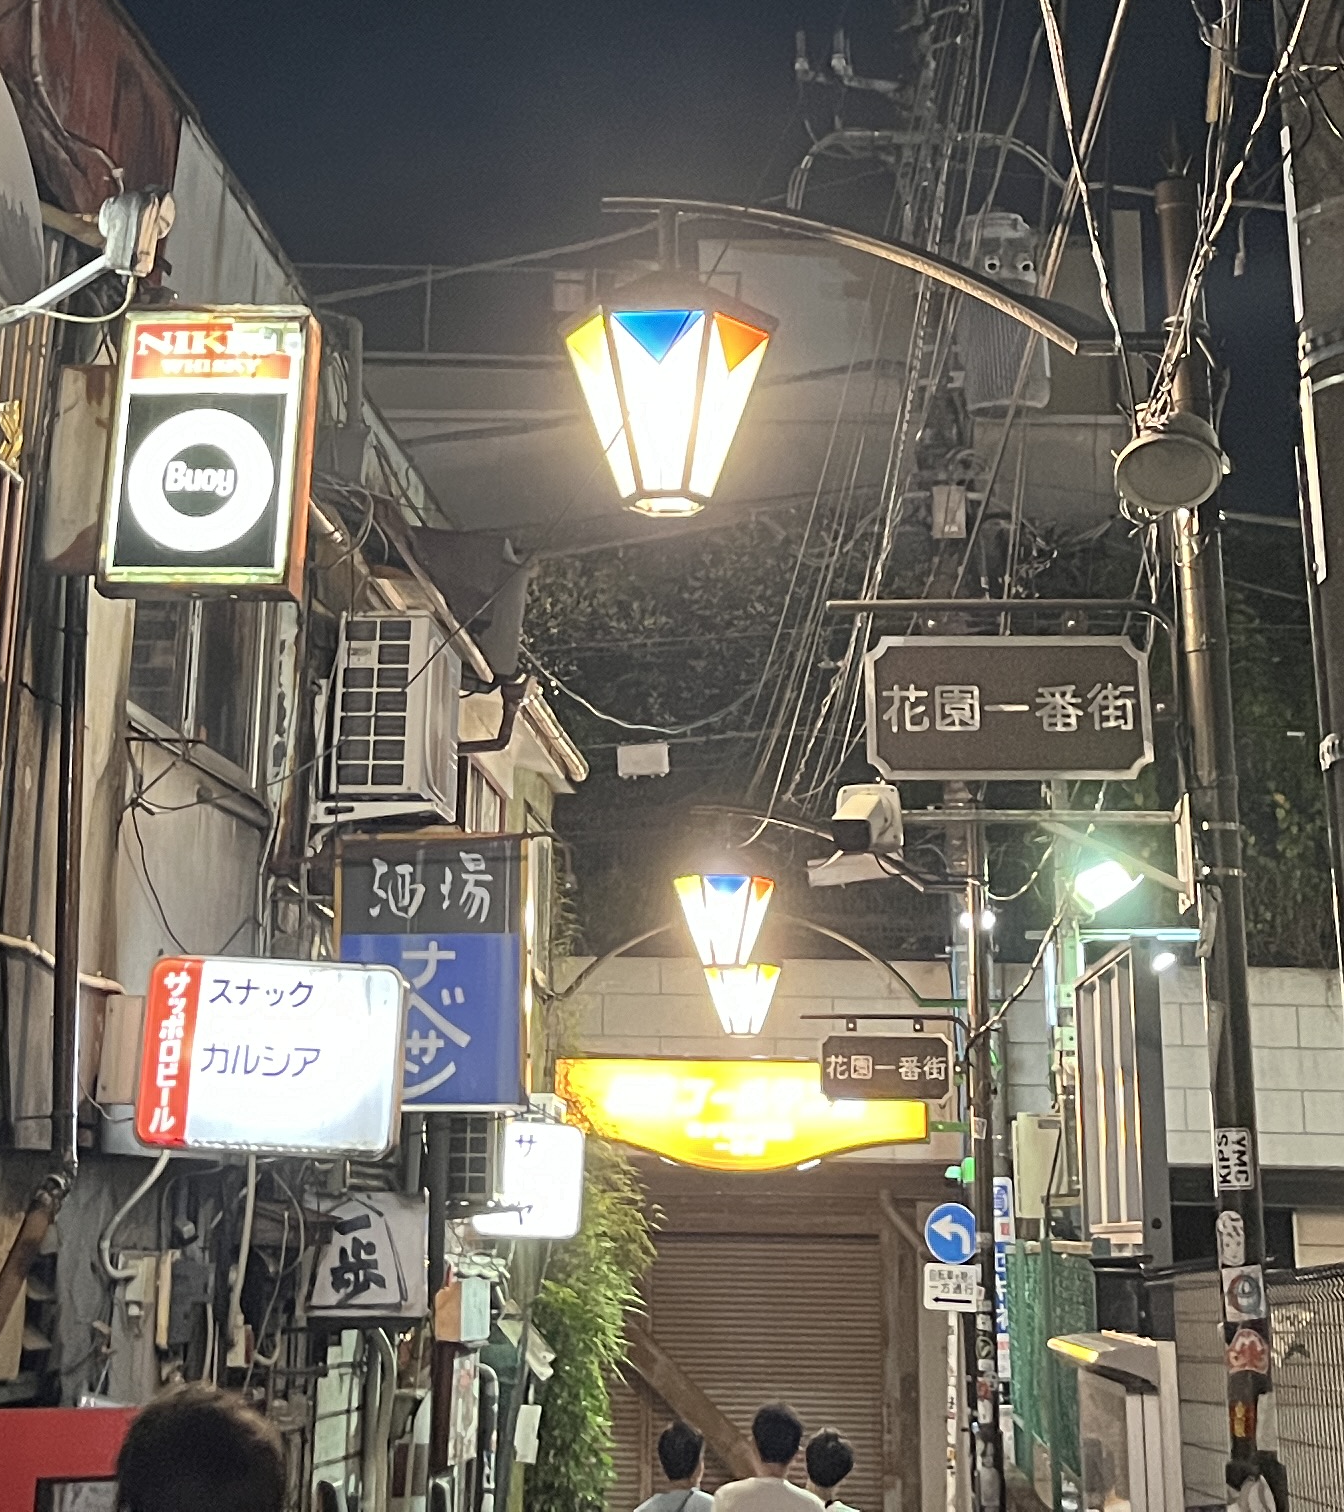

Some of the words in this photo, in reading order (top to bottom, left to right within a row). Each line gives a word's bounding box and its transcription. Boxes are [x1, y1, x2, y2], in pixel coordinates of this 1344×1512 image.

[164, 460, 236, 497] Buoy
[881, 682, 1136, 735] 花園一番街
[369, 851, 494, 924] 酒場
[208, 978, 314, 1008] スナック
[149, 970, 192, 1134] サッポロビール
[825, 1054, 948, 1081] 花園一番街
[1232, 1135, 1250, 1183] YMC
[329, 1213, 388, 1309] 一歩
